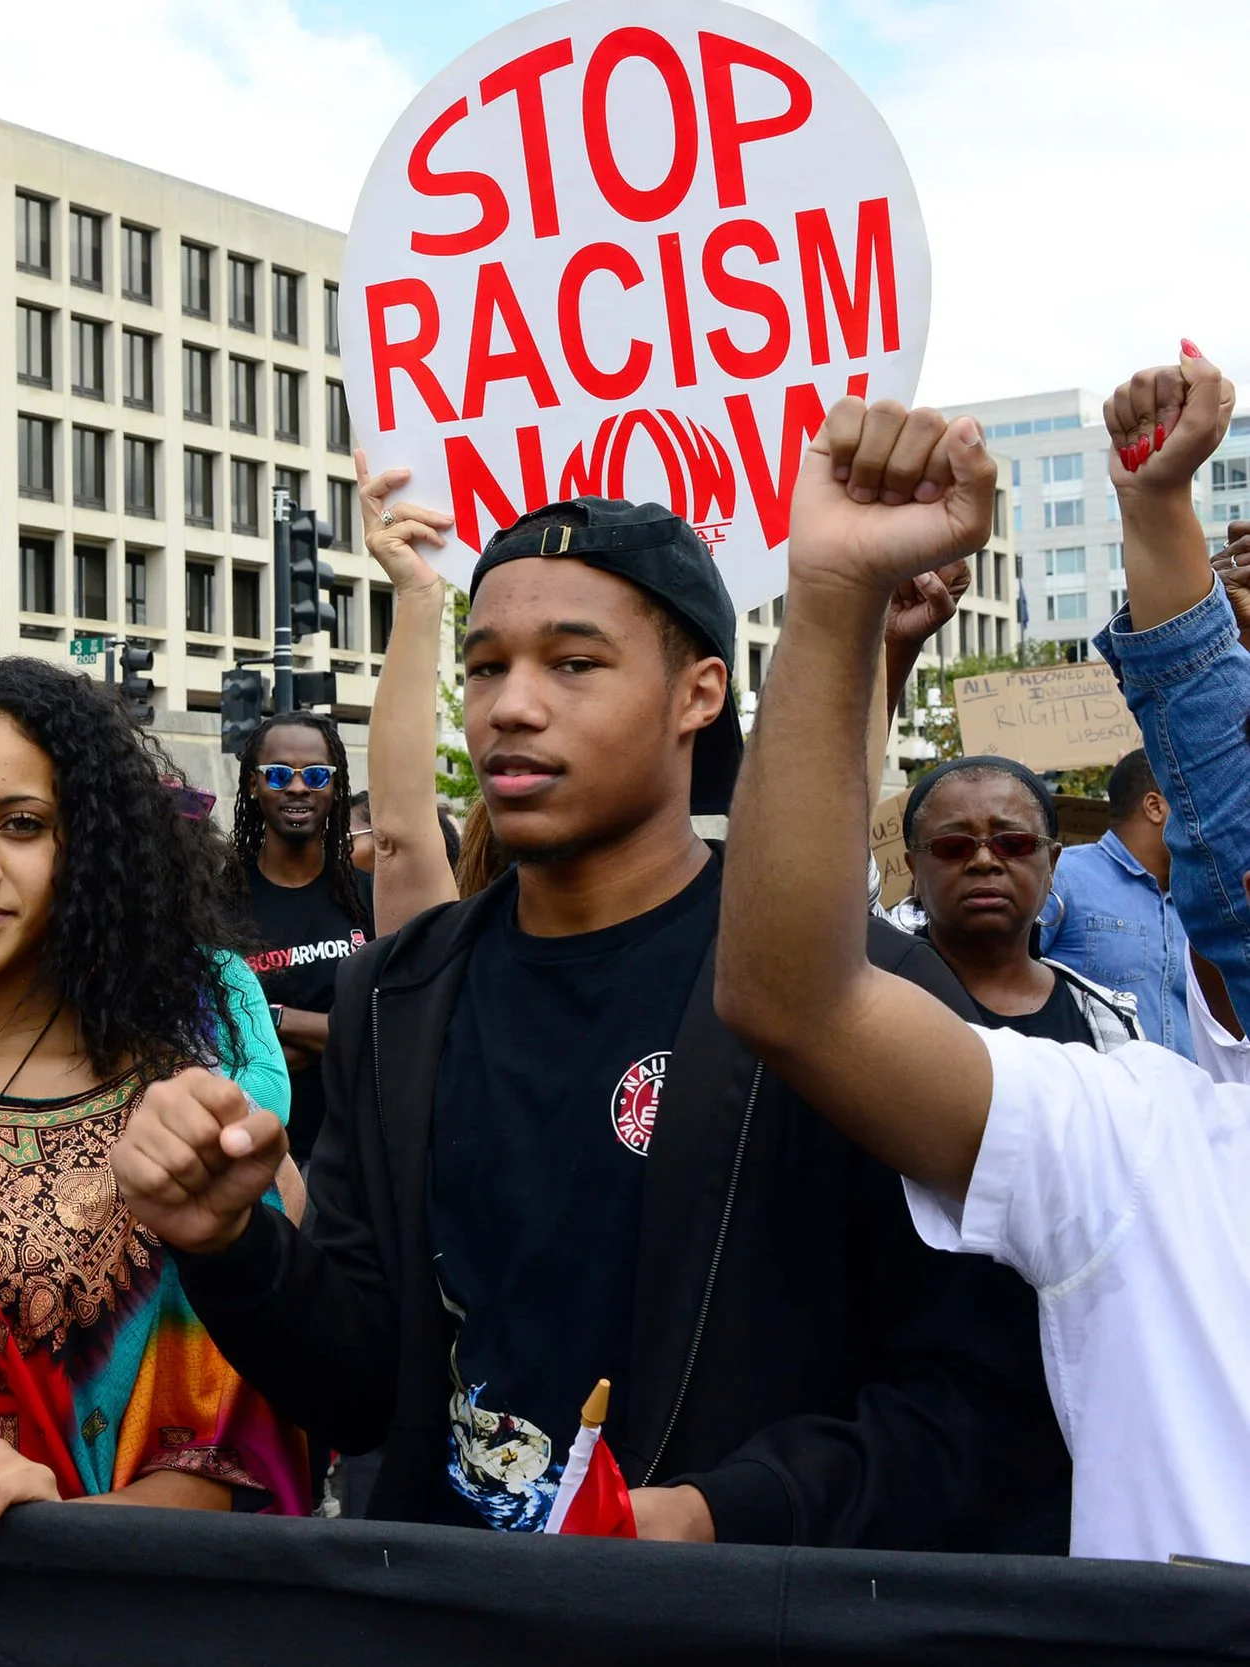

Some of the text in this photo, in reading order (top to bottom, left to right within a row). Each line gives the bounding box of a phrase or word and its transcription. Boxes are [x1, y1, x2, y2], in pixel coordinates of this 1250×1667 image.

[408, 27, 812, 257] STOP
[365, 197, 900, 432] RACISM
[75, 641, 82, 654] 3
[77, 653, 96, 664] 200
[992, 700, 1120, 730] RIGHTS
[1067, 723, 1132, 744] LIBERTY
